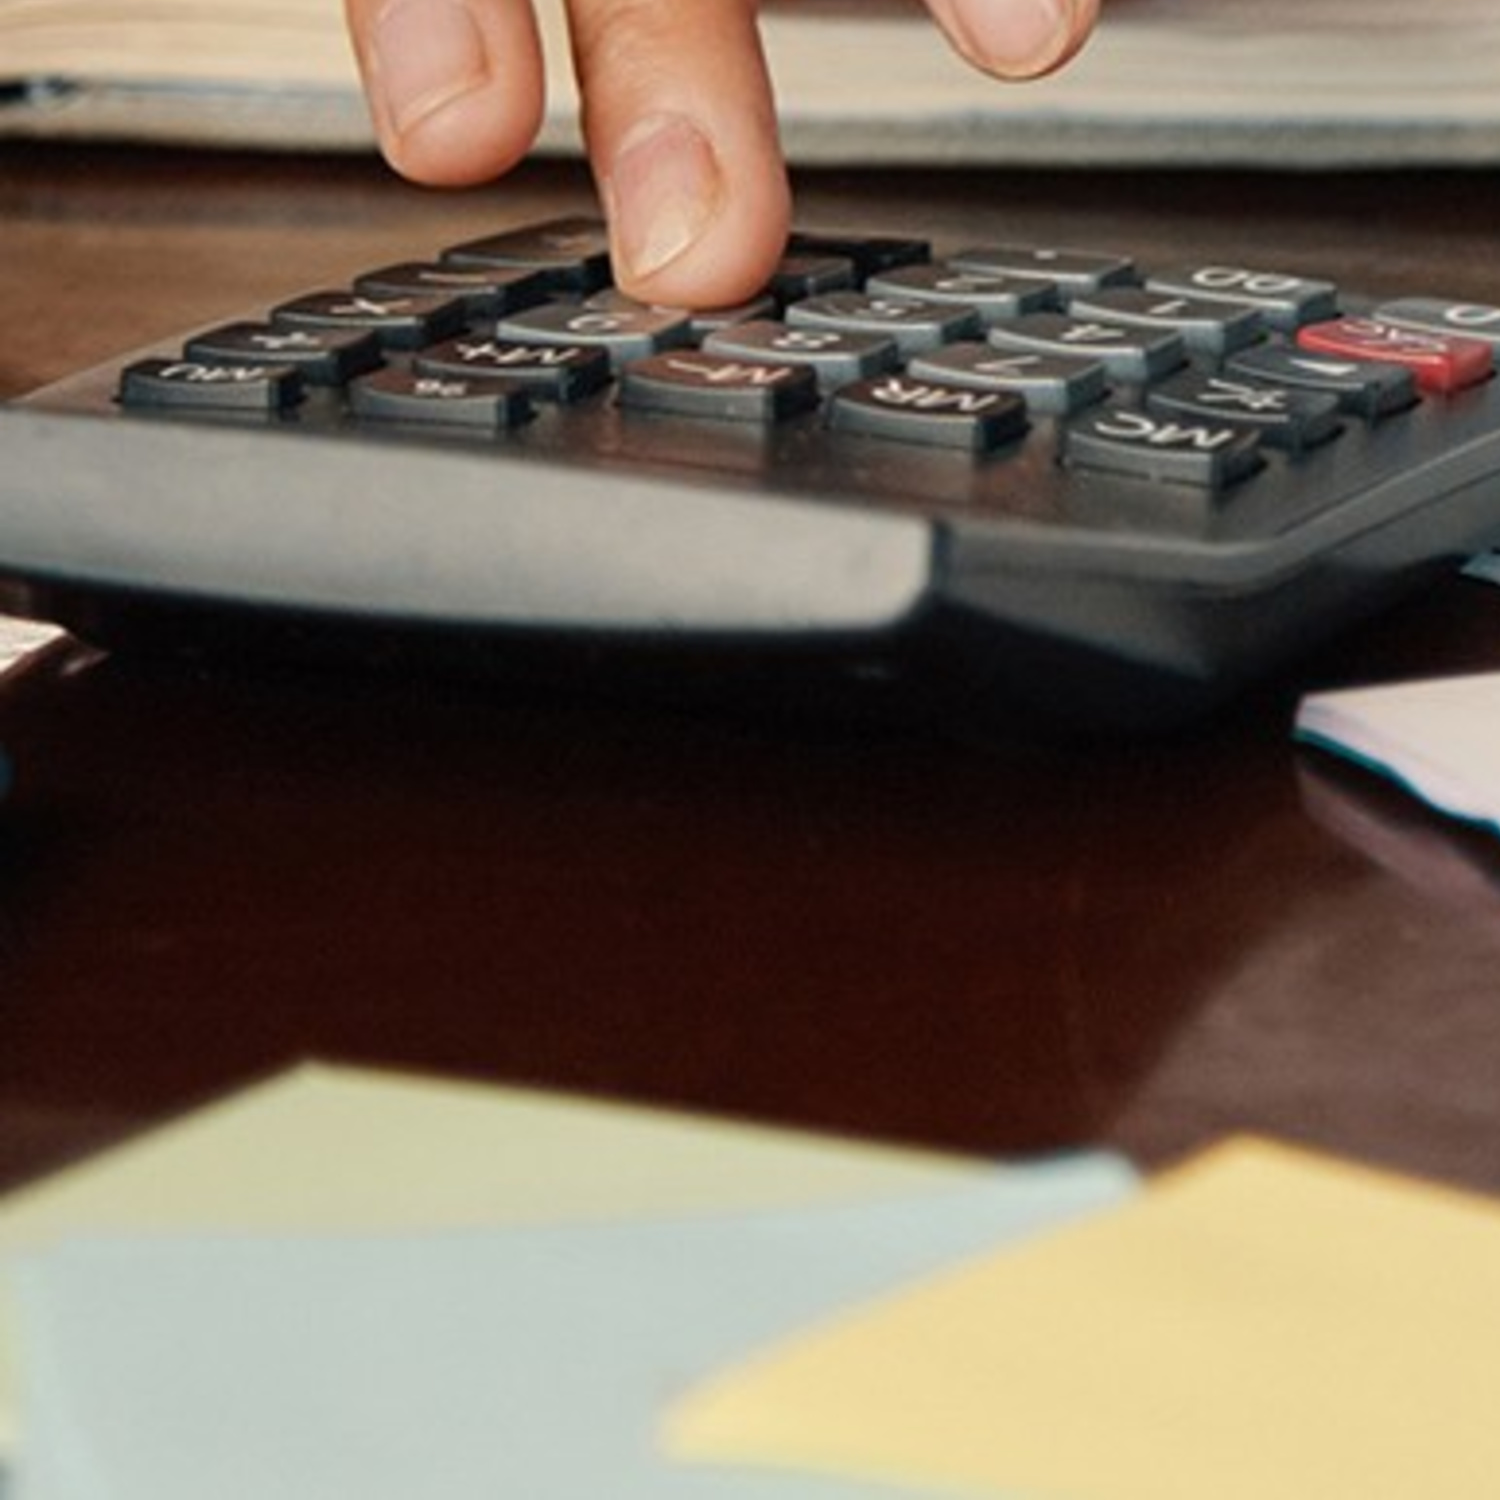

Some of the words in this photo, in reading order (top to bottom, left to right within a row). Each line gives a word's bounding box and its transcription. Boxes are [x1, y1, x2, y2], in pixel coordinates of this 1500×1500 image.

[774, 331, 842, 349] 8
[1062, 323, 1125, 341] 4
[455, 342, 580, 364] M+
[974, 355, 1042, 375] 7
[871, 378, 1000, 412] MR
[1094, 411, 1234, 450] MC
